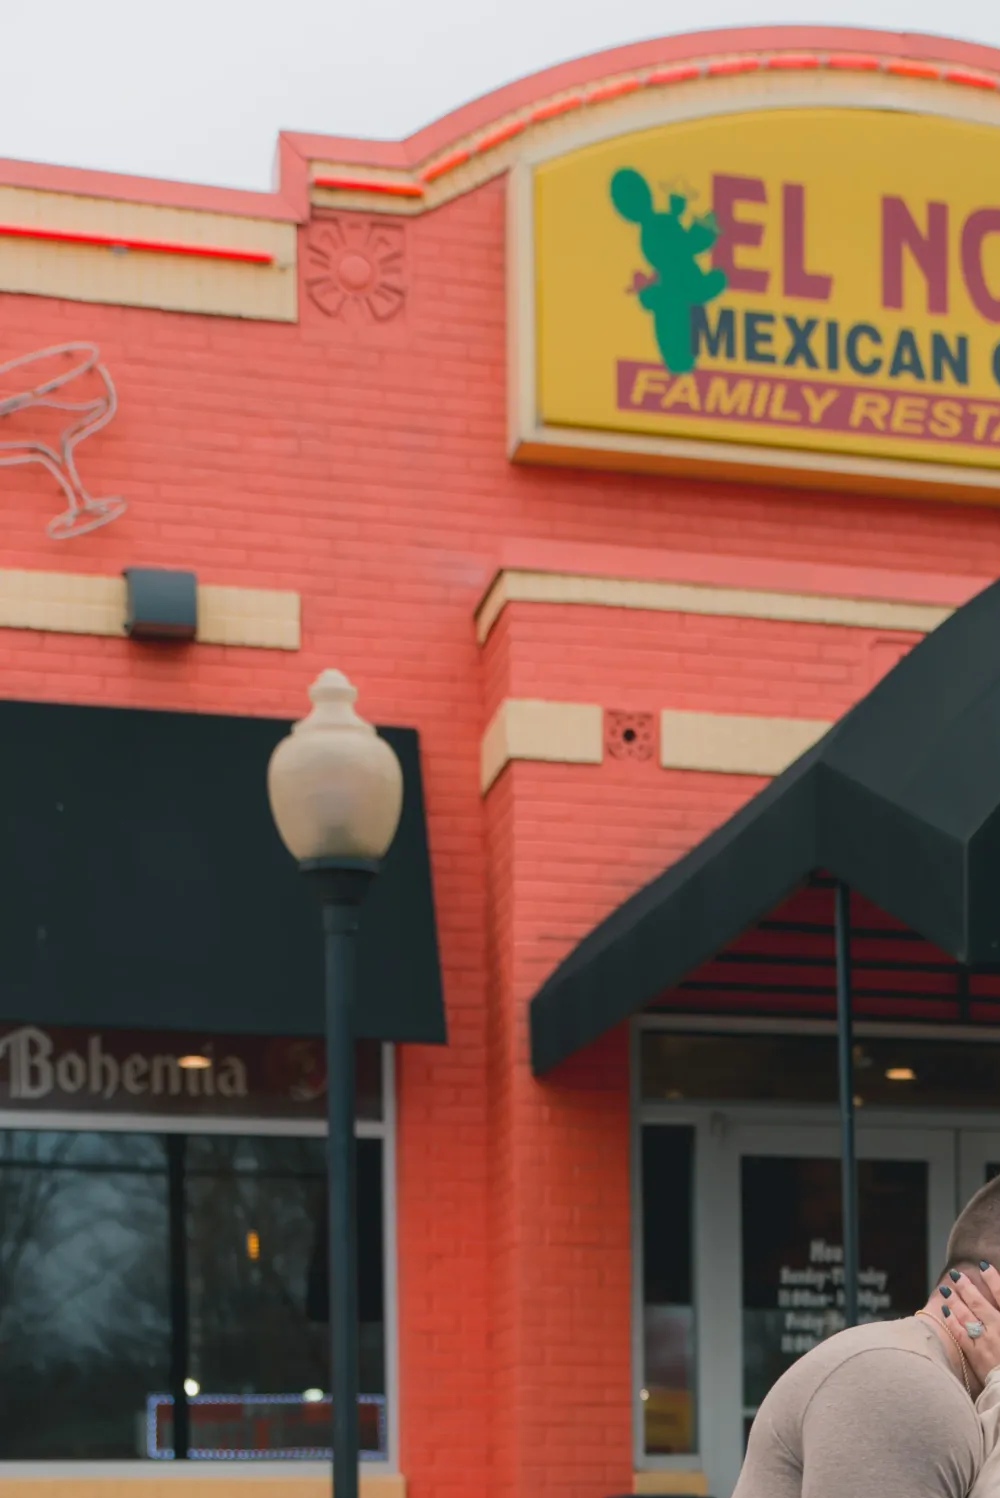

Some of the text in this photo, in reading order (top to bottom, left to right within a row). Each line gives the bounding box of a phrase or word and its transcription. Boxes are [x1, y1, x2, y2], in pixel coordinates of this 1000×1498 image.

[711, 172, 834, 302] EL
[689, 304, 970, 385] MEXICAN
[630, 369, 843, 425] FAMILY
